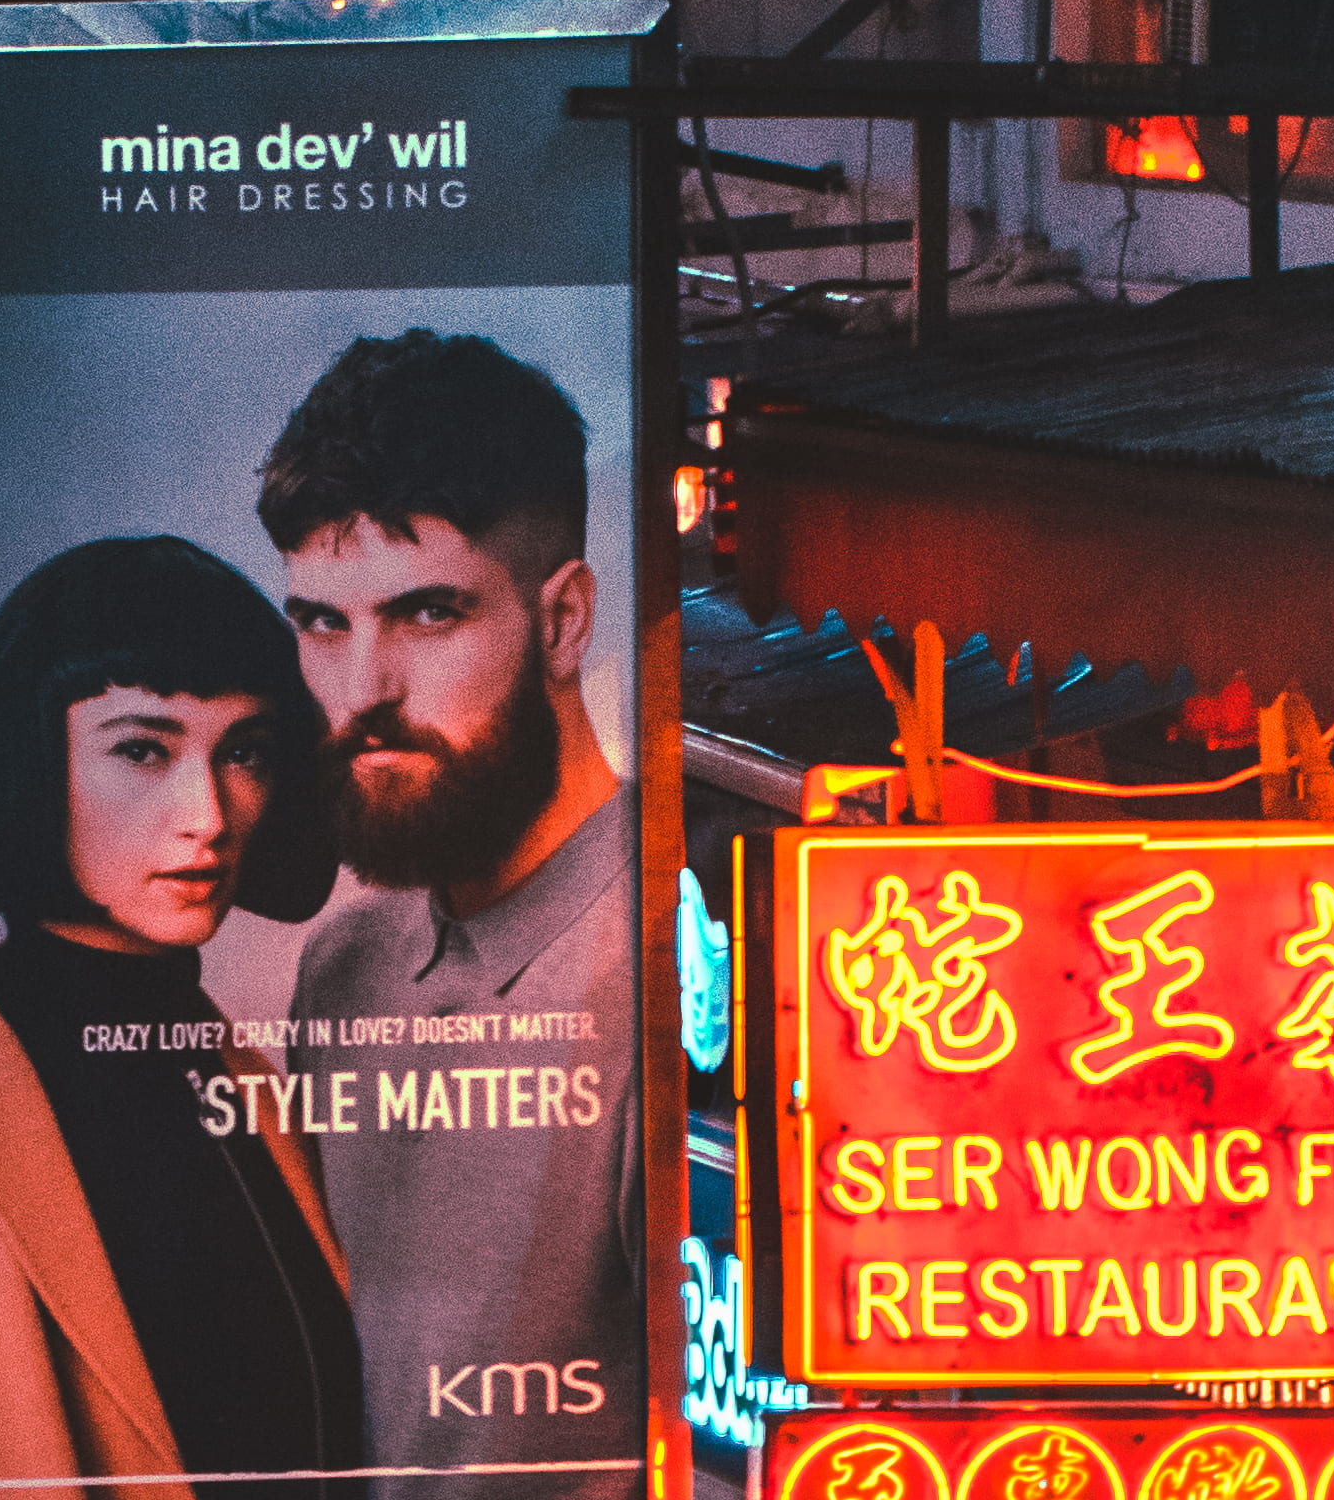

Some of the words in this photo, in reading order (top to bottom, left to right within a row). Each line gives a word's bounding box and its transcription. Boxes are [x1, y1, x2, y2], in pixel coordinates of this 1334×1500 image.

[101, 123, 241, 173] mina
[388, 119, 468, 169] wil
[101, 184, 207, 213] HAIR
[238, 180, 468, 212] DRESSING
[82, 1023, 151, 1052] CRAZY
[159, 1021, 225, 1051] LOVE?
[232, 1019, 301, 1049] CRAZY
[307, 1018, 333, 1047] IN
[339, 1016, 405, 1048] LOVE?
[205, 1071, 359, 1138] STYLE
[377, 1064, 603, 1132] MATTERS
[830, 1135, 1004, 1214] SER
[1025, 1128, 1271, 1212] WONG
